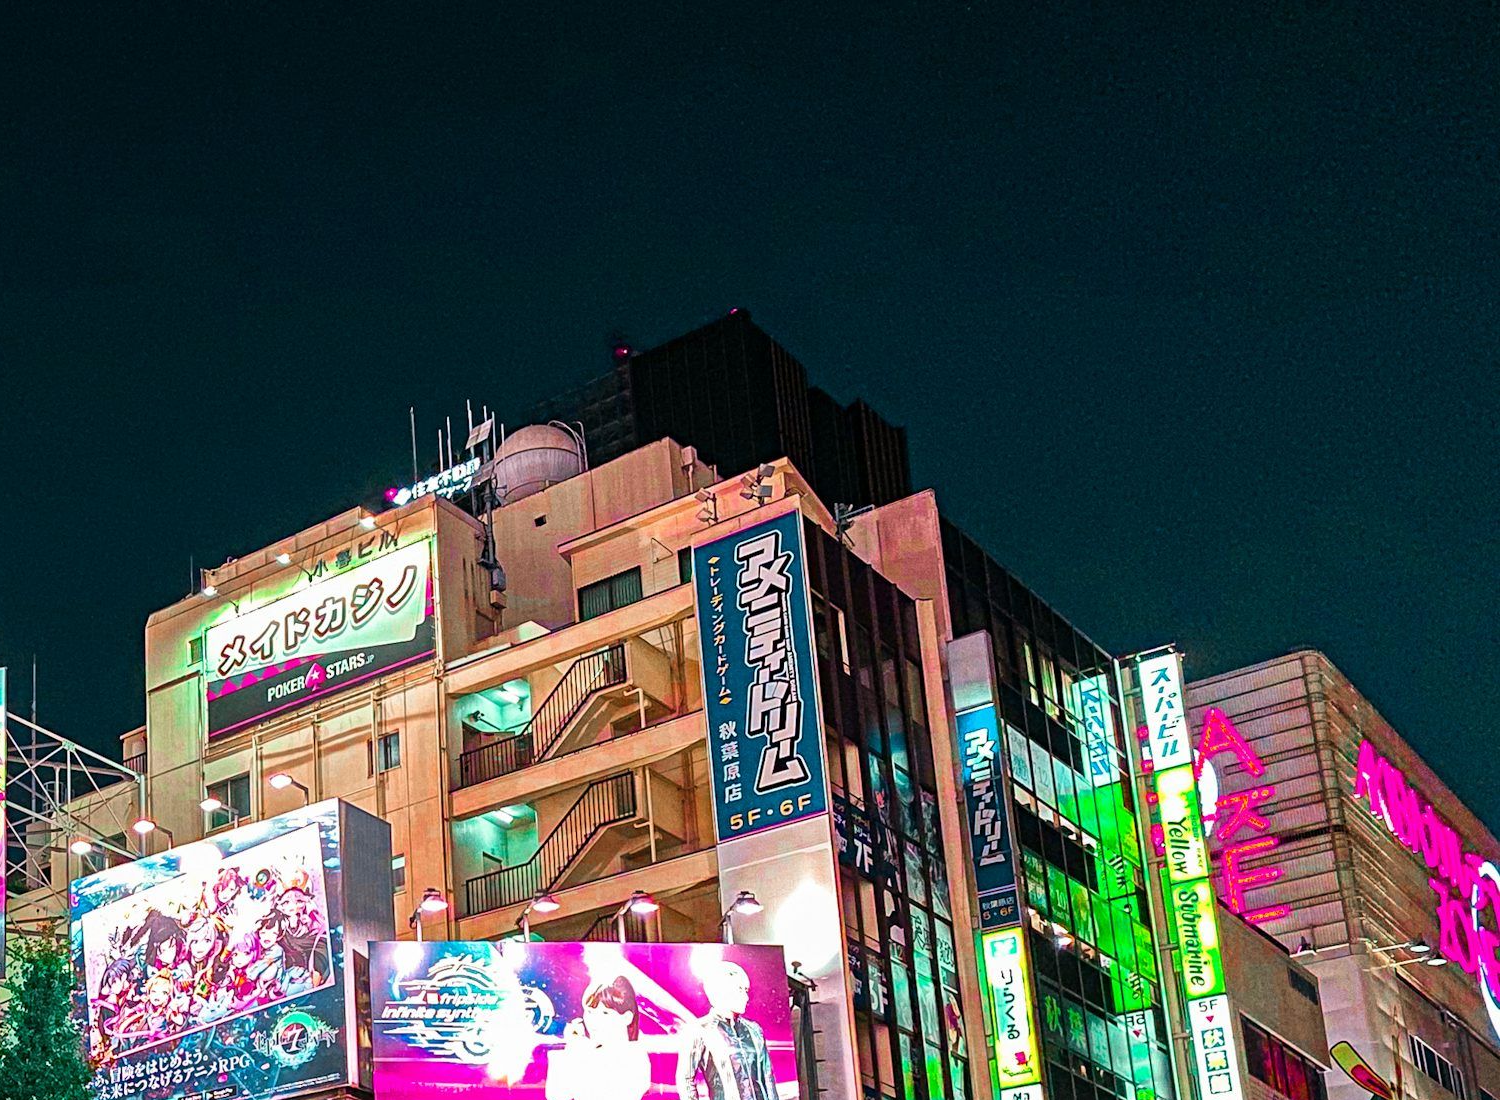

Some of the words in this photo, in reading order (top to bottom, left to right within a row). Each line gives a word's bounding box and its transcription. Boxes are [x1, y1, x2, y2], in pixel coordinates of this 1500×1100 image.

[217, 566, 417, 676] メイドカジノ
[709, 566, 732, 697] トレーディングカードゲーム
[268, 676, 305, 702] POKER
[1150, 667, 1179, 757] スーパービル
[719, 721, 743, 804] 秋葉原店
[1168, 816, 1189, 875] Yellow
[1177, 889, 1206, 988] Submarine
[999, 968, 1022, 1040] りらくる
[1199, 1001, 1218, 1013] 5F
